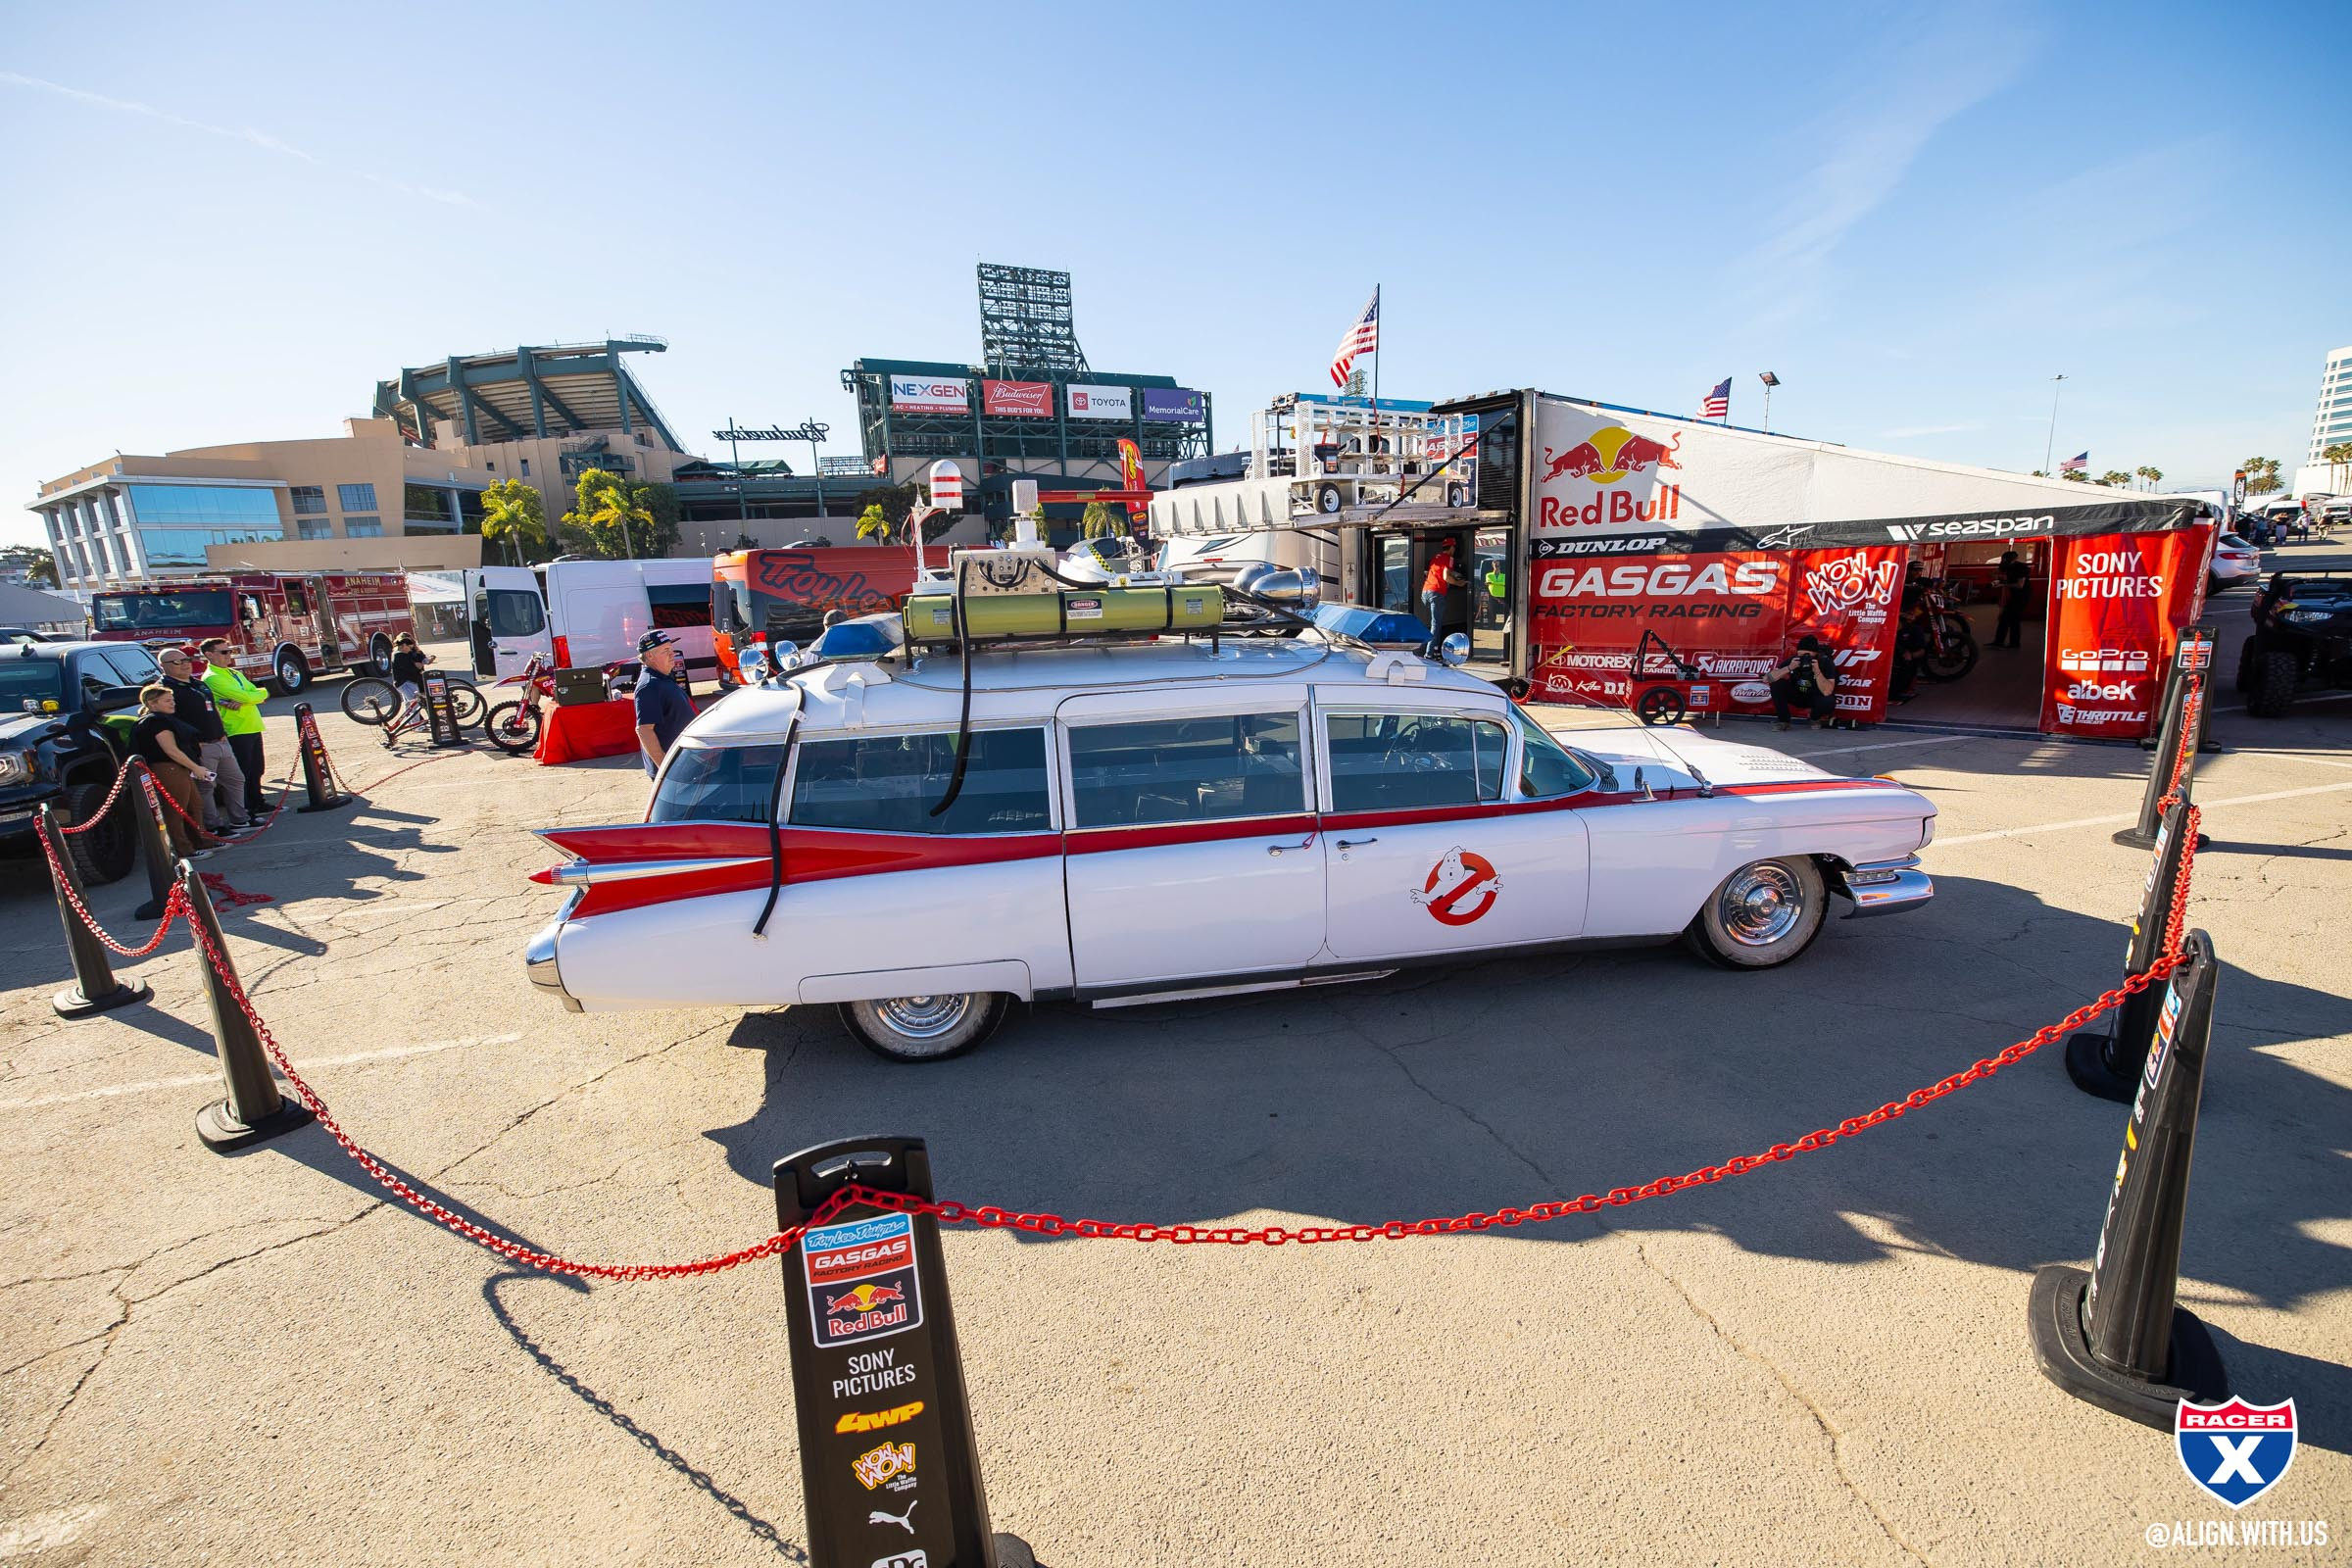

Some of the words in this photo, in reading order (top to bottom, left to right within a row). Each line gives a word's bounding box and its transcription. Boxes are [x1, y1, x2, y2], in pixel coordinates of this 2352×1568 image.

[893, 382, 966, 398] NEXGEN
[994, 387, 1043, 399] Budweiser
[1091, 398, 1126, 407] TOYOTA
[1149, 406, 1199, 416] MemorialCare
[1541, 490, 1604, 527] Red
[1609, 484, 1680, 523] Bull
[1929, 515, 2054, 537] seaspan
[1556, 538, 1667, 554] DUNLOP
[2077, 551, 2142, 575] SONY
[345, 577, 381, 587] ANAHEIM
[1539, 561, 1780, 598] GASGAS
[2055, 575, 2164, 600] PICTURES
[1533, 605, 1643, 618] FACTORY
[1648, 604, 1762, 618] RACING
[1857, 615, 1886, 624] Company
[1567, 654, 1633, 668] MOTOREX
[2061, 649, 2148, 660] GoPro
[2067, 679, 2136, 701] albek
[2076, 710, 2148, 722] THROTTLE
[808, 1233, 834, 1248] Troy
[834, 1231, 857, 1244] Lee
[814, 1240, 906, 1269] GASGAS
[813, 1263, 862, 1277] FACTORY
[863, 1254, 904, 1269] RACING
[828, 1312, 868, 1337] Red
[868, 1302, 907, 1330] Bull
[848, 1348, 895, 1375] SONY
[832, 1363, 916, 1398] PICTURES
[835, 1400, 924, 1435] 4WP
[885, 1481, 900, 1490] Little
[900, 1477, 917, 1486] Waffle
[894, 1482, 917, 1493] Company
